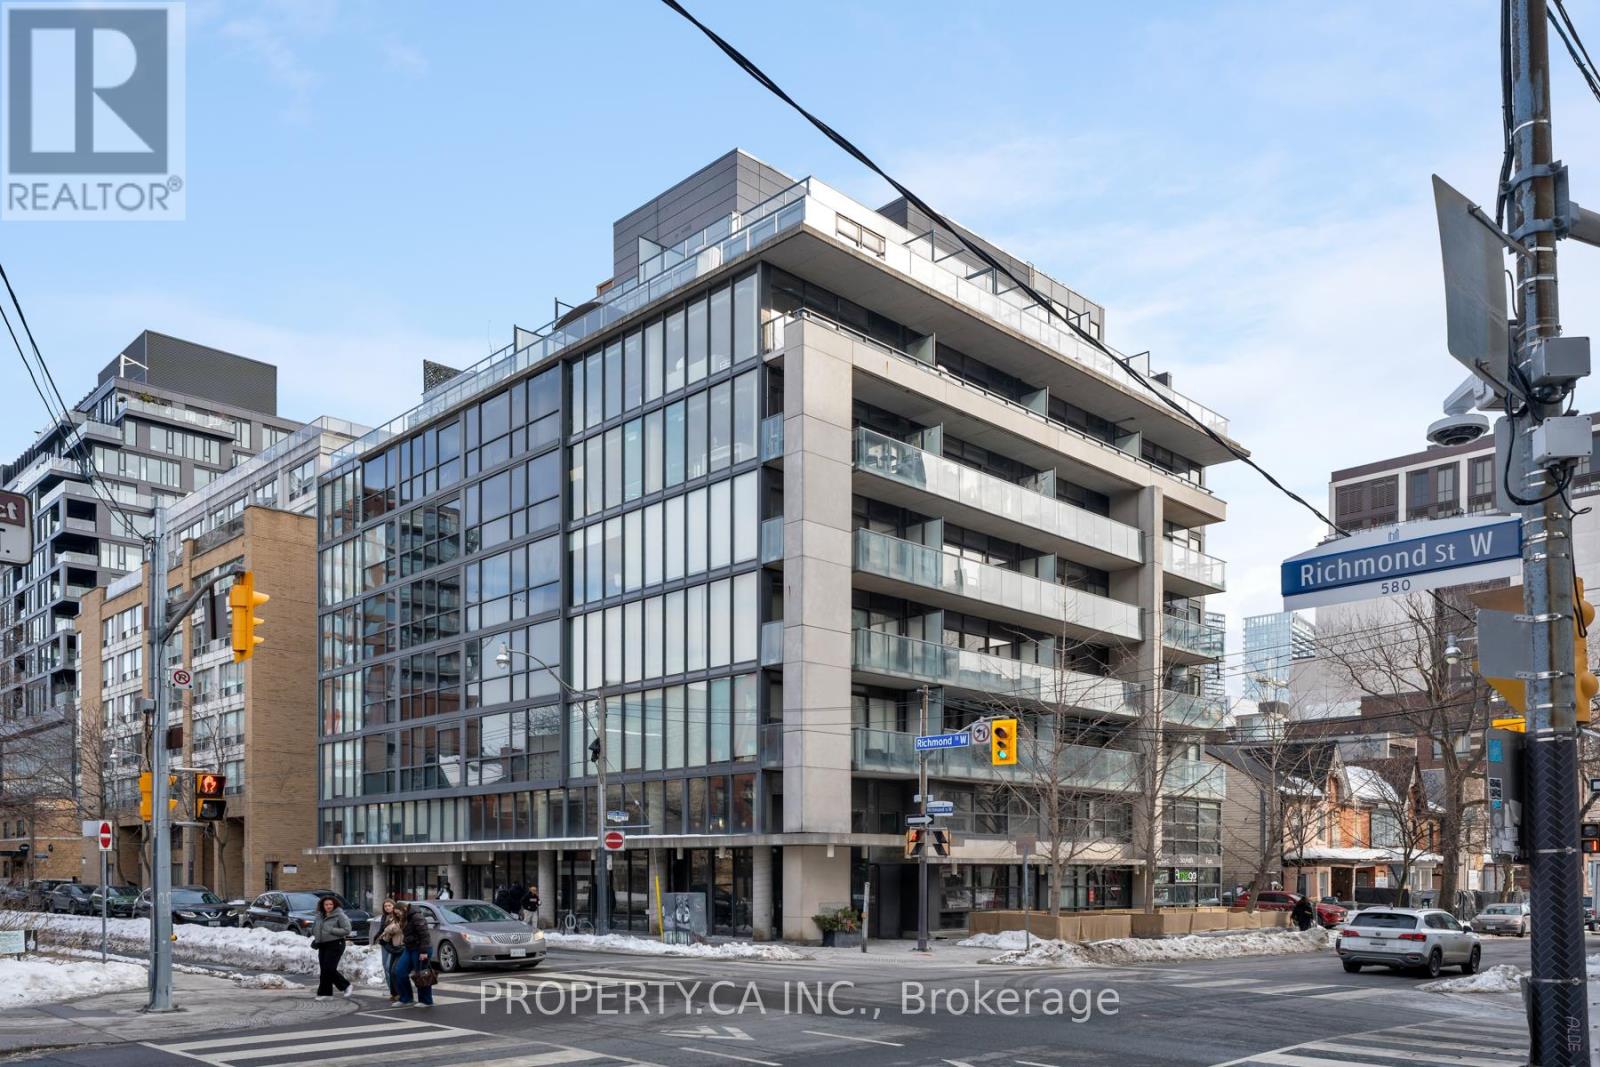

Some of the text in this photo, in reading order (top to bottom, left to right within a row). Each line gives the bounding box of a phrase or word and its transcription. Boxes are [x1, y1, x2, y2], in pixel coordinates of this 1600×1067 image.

[1300, 531, 1493, 587] Richmond St W
[1381, 579, 1411, 595] 580
[917, 736, 953, 748] Richmond
[960, 735, 967, 745] W
